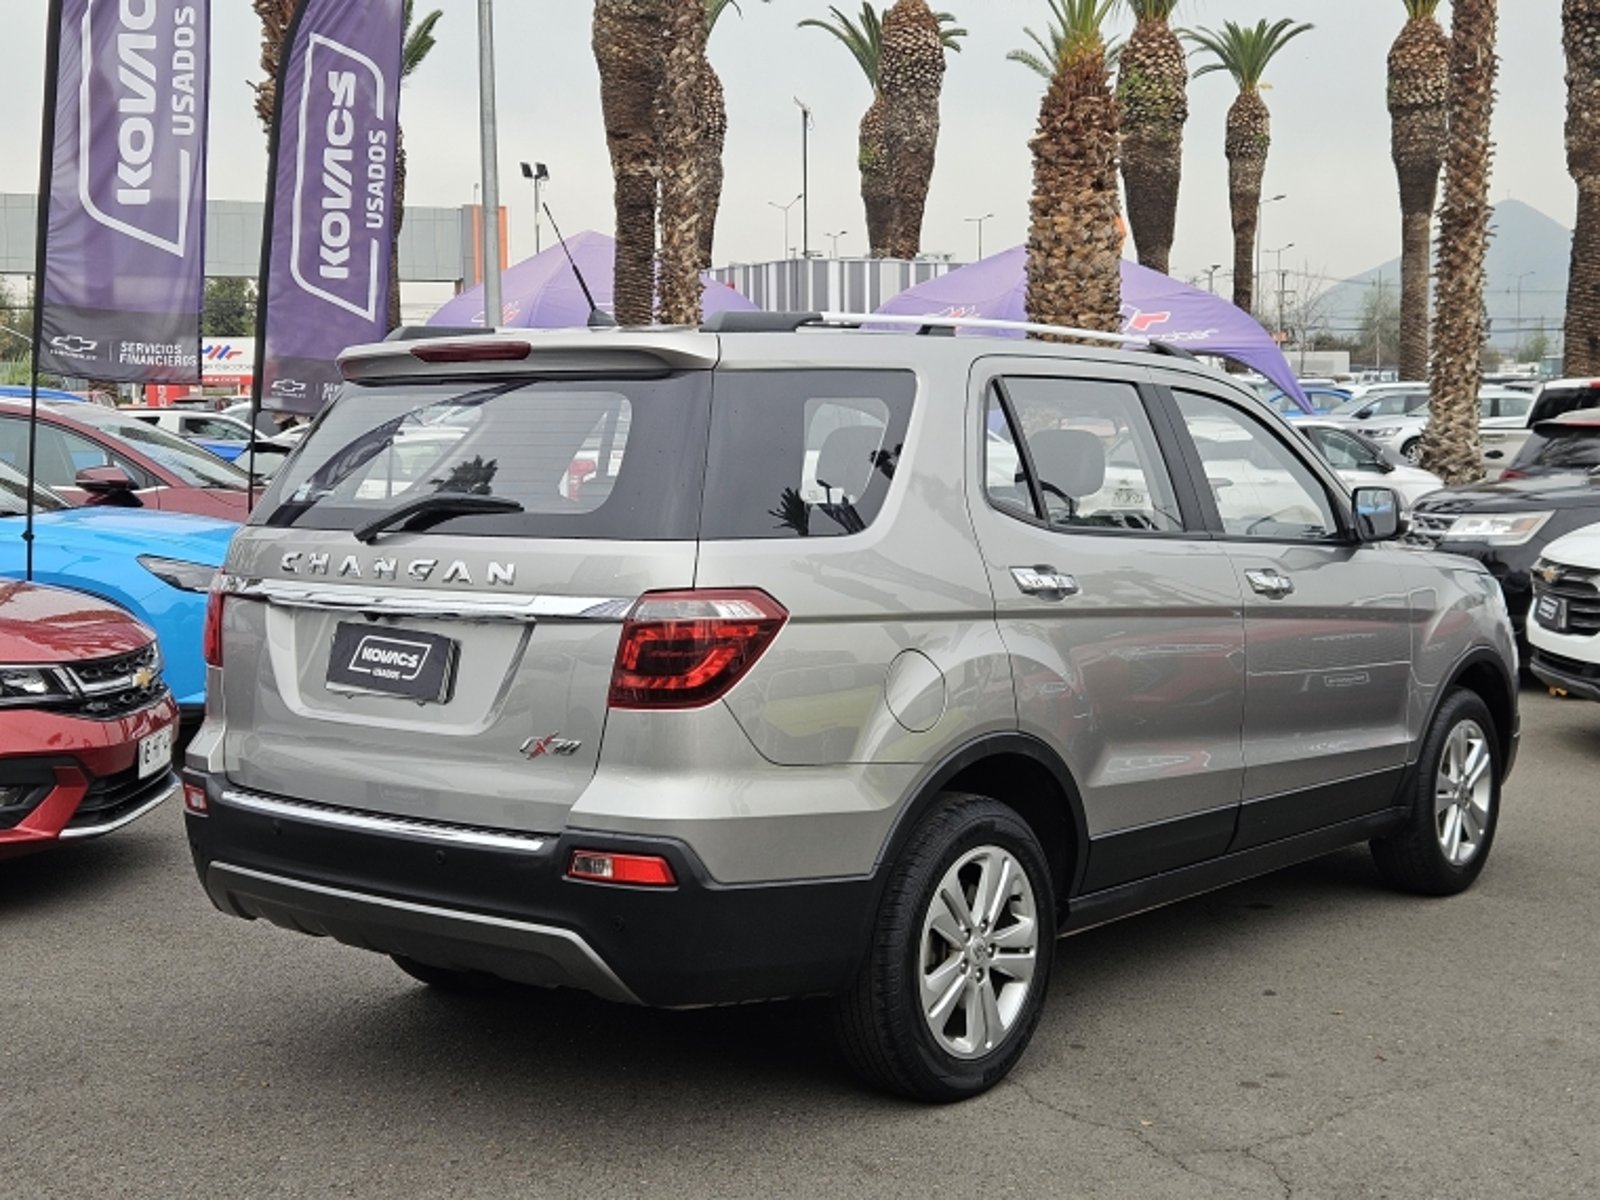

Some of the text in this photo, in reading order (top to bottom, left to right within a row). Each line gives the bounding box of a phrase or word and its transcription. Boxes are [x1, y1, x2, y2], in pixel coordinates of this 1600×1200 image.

[172, 6, 195, 136] USADOS
[319, 70, 357, 280] KOVACS
[366, 129, 387, 229] USADOS
[119, 341, 182, 355] SERVICIOS
[119, 353, 198, 367] FINANCIEROS
[279, 551, 518, 586] CHANGAN
[361, 646, 420, 669] KOVACS
